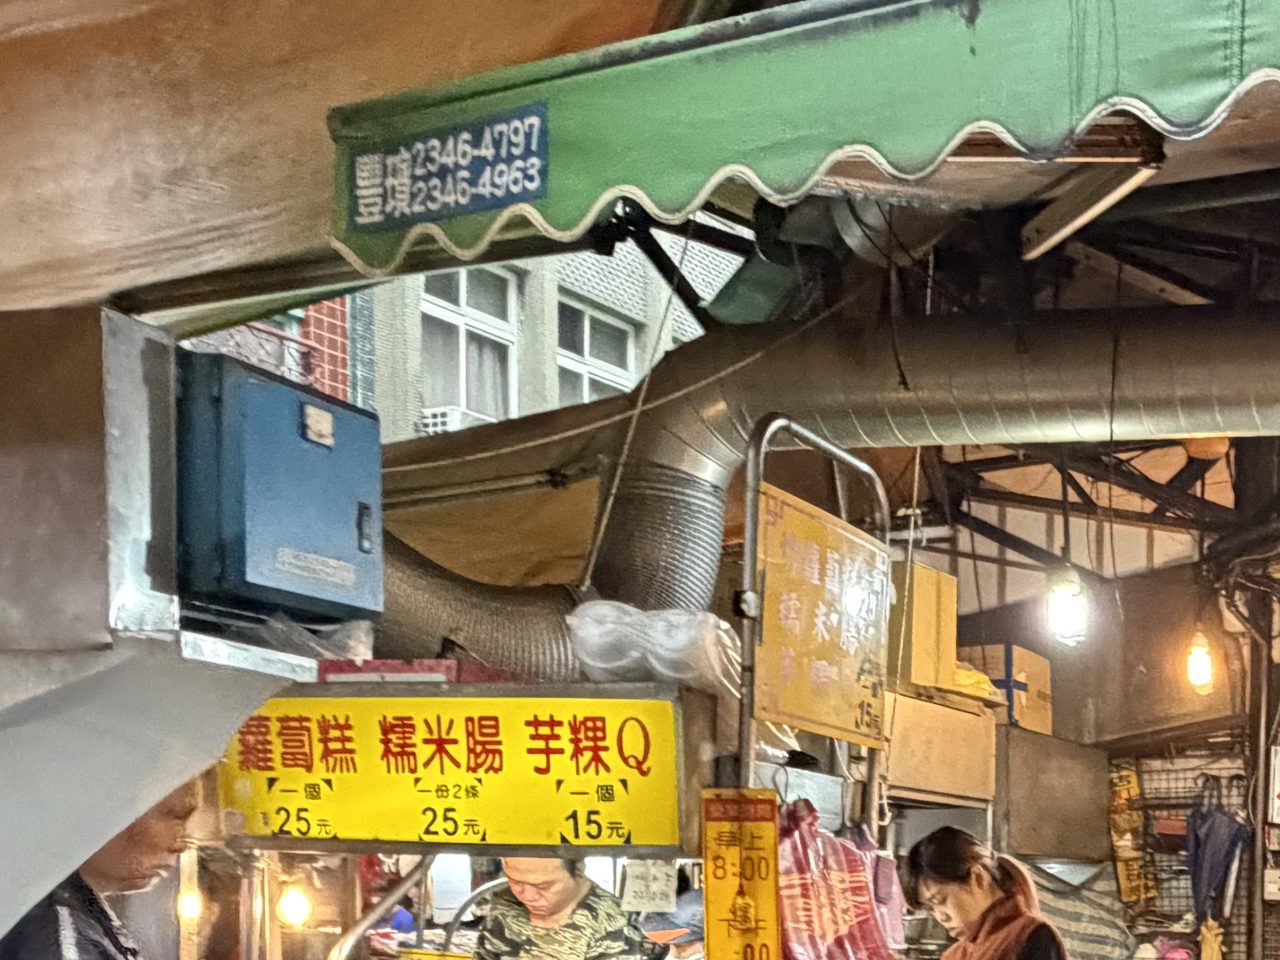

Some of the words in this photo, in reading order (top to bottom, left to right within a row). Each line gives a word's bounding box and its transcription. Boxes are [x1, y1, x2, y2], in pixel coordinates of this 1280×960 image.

[411, 115, 541, 177] 2346-4797
[411, 156, 541, 215] 2346-4963
[237, 714, 357, 774] 蘿蔔糕
[379, 714, 503, 775] 糯米腸
[524, 713, 652, 777] 芋粿Q
[569, 784, 616, 802] 一個
[275, 806, 332, 837] 25元
[422, 806, 481, 837] 25元
[565, 809, 626, 840] 15元
[712, 856, 769, 881] 8:00
